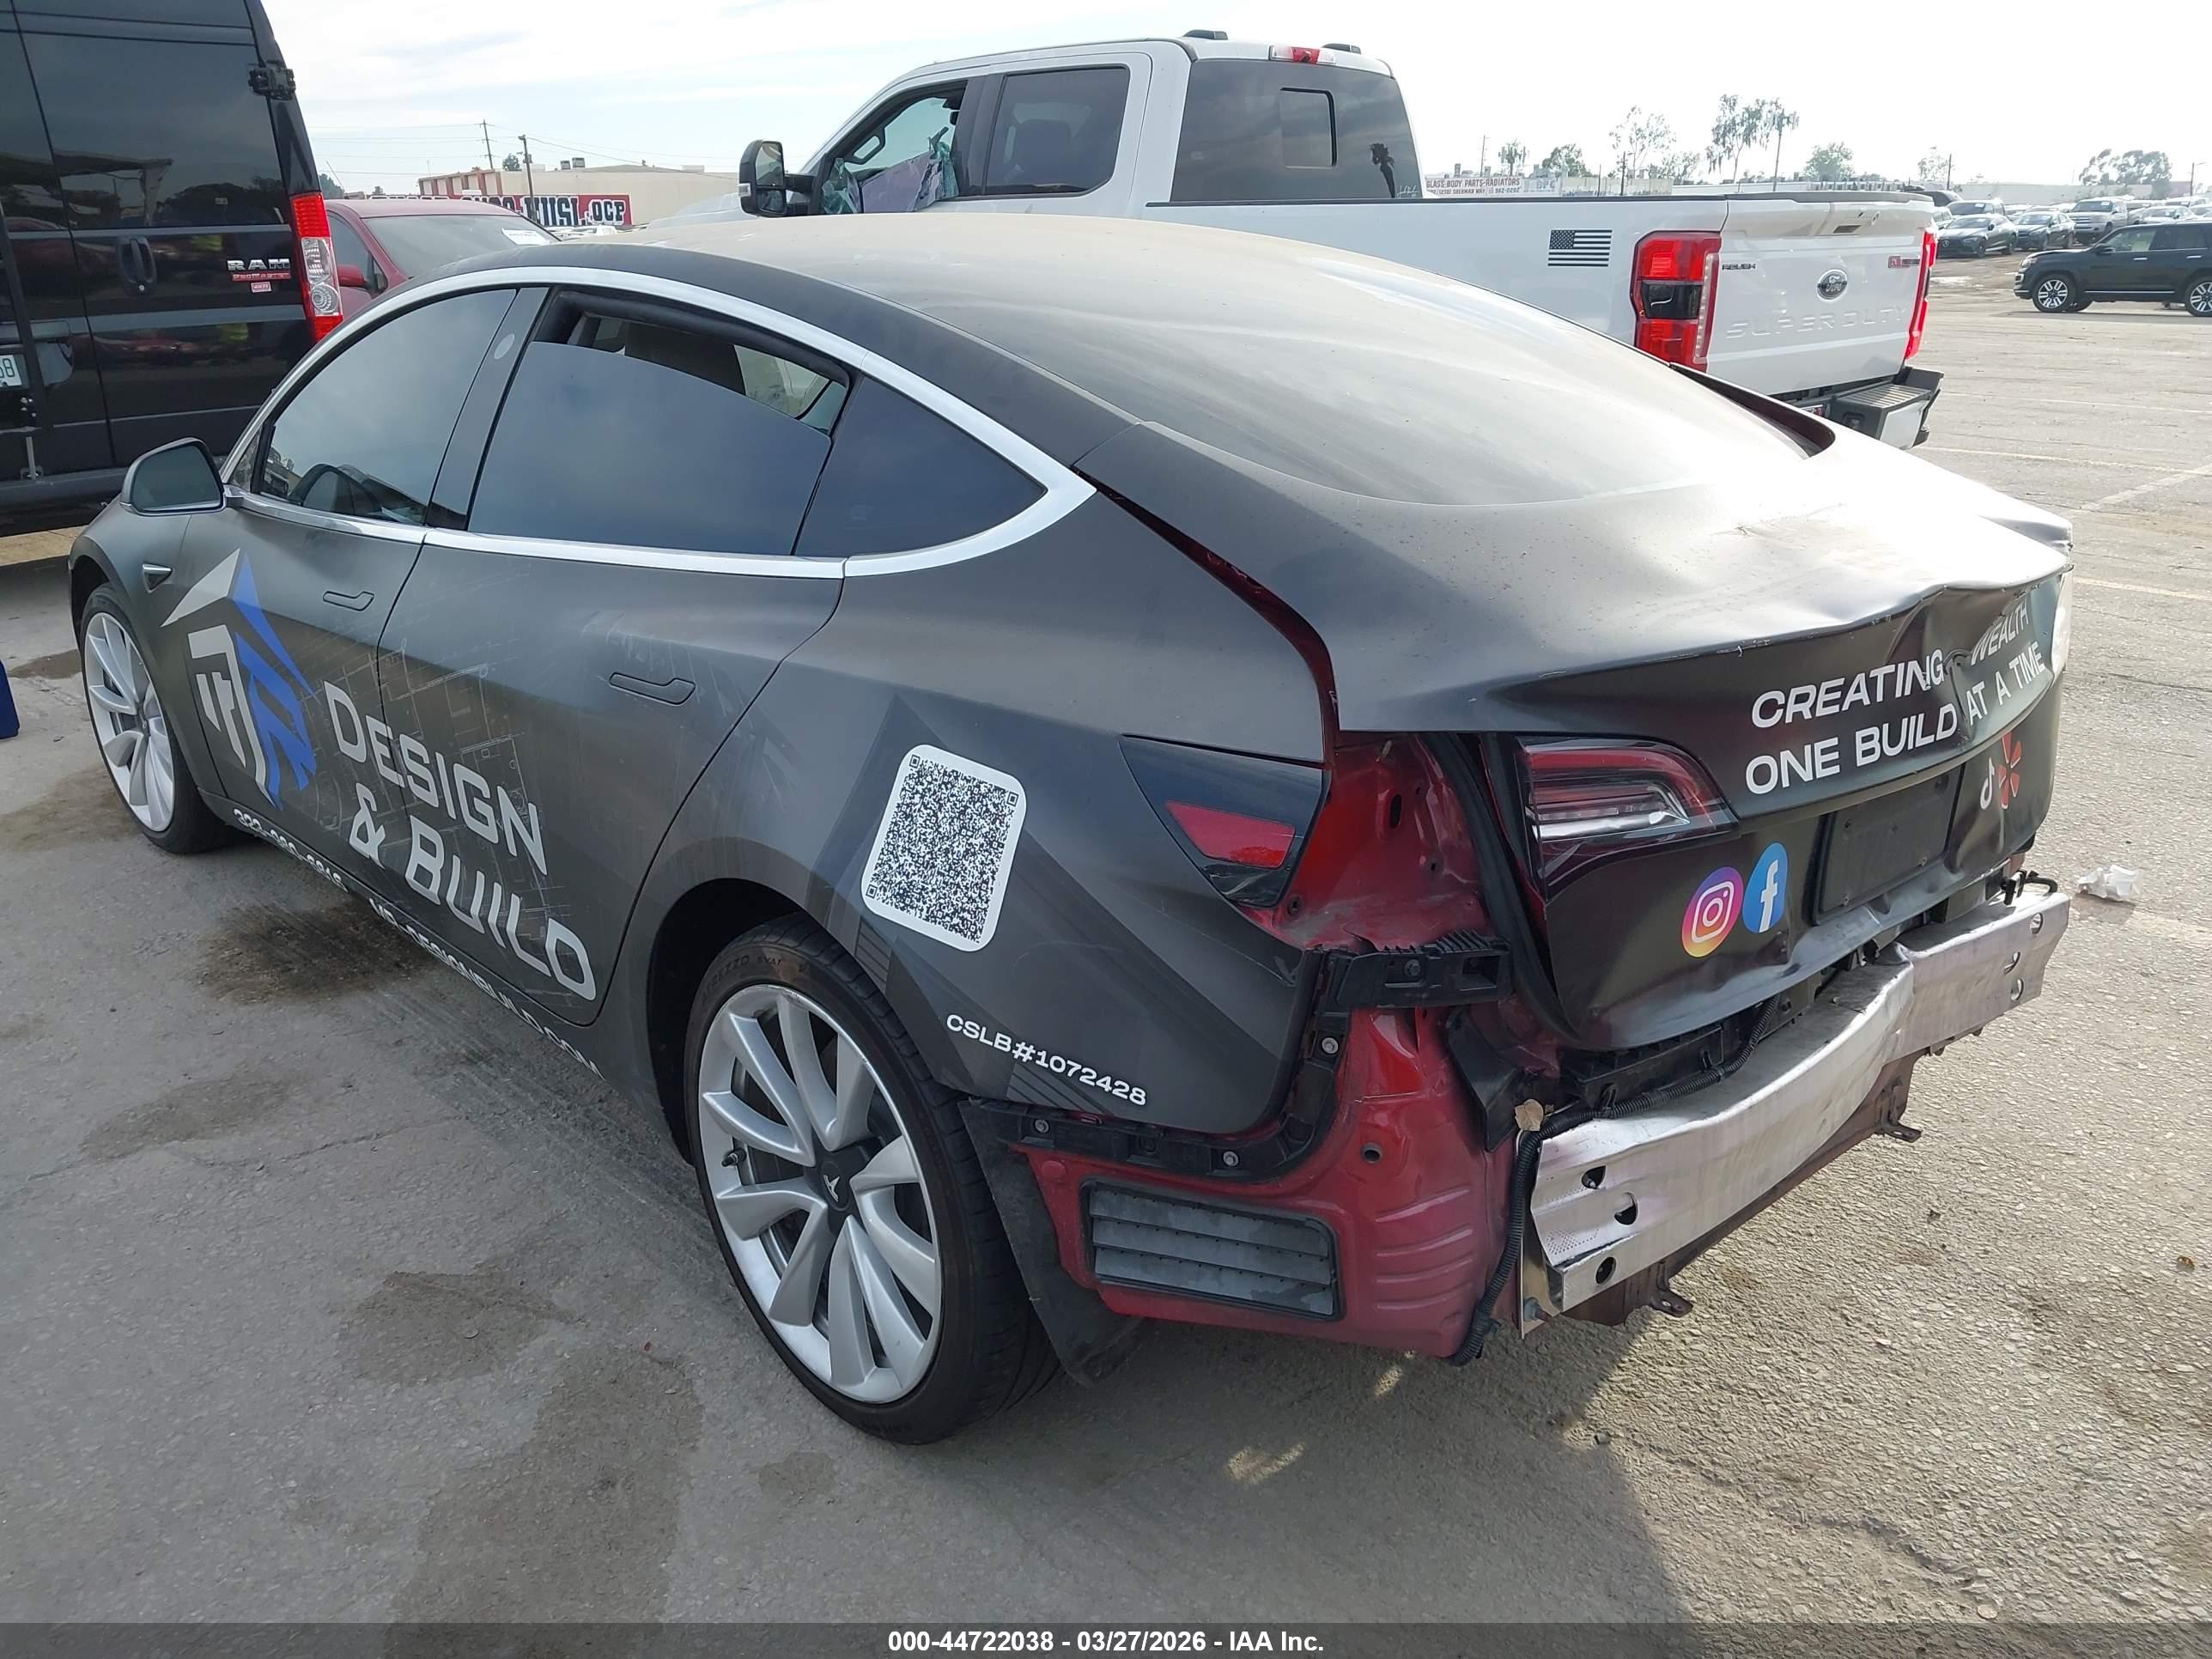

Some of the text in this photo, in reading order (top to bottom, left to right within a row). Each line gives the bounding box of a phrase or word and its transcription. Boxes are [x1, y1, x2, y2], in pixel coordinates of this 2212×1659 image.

[227, 258, 290, 270] RAM
[1724, 307, 1907, 339] SUPER DUTY
[1746, 641, 2046, 795] ONE BUILD AT A TIME
[1752, 601, 2030, 728] CREATING WEALTH
[324, 680, 547, 876] DESIGN
[349, 782, 386, 870] &
[404, 814, 596, 1001] BUILD
[946, 1014, 1147, 1106] CSLB#1072428
